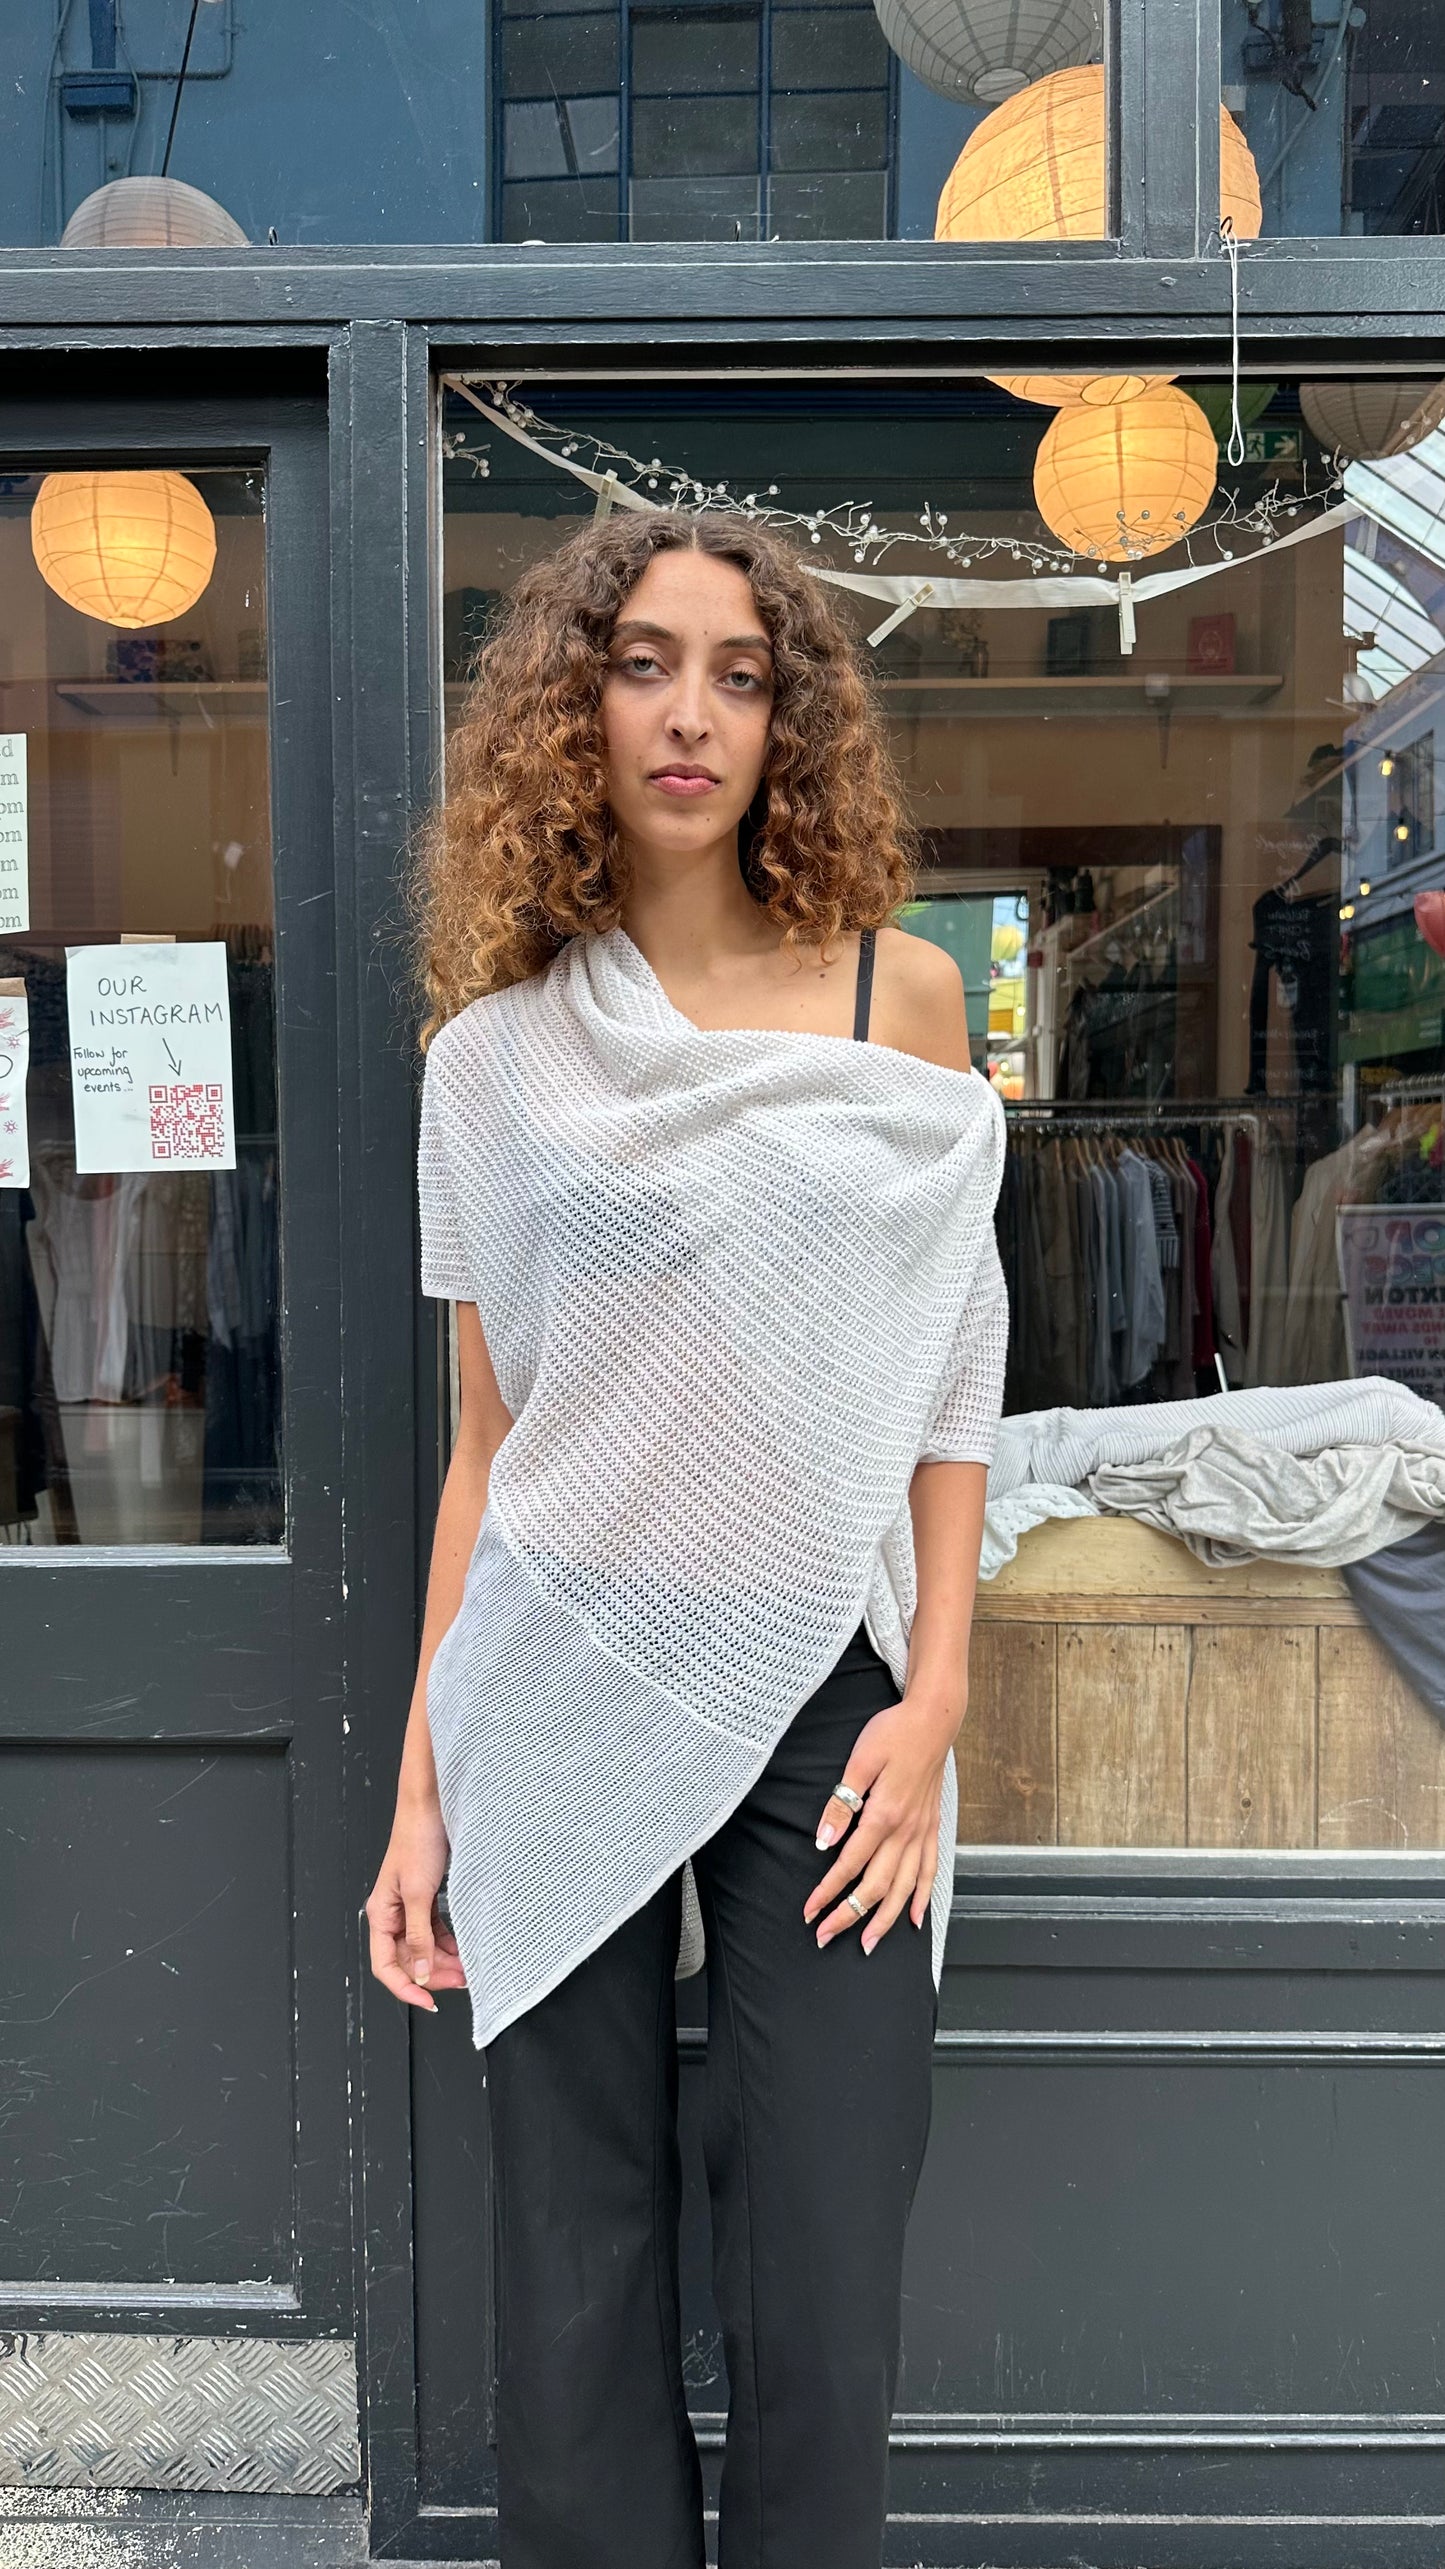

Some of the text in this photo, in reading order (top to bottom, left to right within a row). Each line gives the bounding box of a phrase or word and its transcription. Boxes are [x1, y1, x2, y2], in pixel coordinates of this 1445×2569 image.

[98, 975, 147, 996] OUR
[90, 1002, 223, 1026] INSTAGRAM
[73, 1046, 128, 1067] Follow for
[77, 1065, 133, 1084] upcoming
